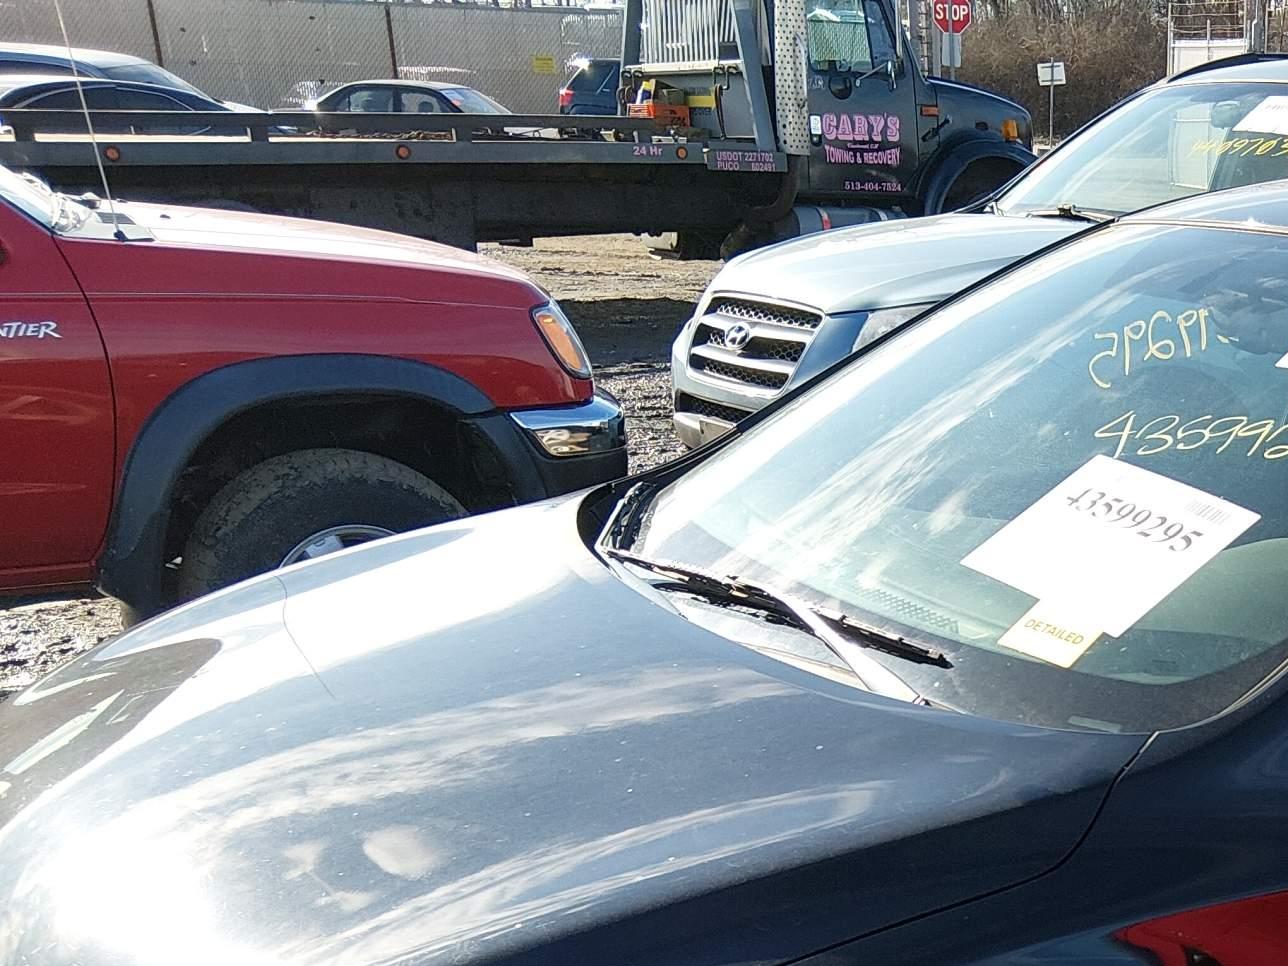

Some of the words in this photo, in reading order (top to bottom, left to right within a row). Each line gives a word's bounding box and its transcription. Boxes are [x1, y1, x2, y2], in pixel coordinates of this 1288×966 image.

[935, 3, 969, 21] STOP
[632, 145, 647, 156] 24
[649, 145, 663, 156] Hr
[824, 144, 855, 164] TOWING
[856, 152, 863, 164] &
[863, 146, 901, 165] RECOVERY
[1065, 487, 1204, 552] 43599295
[1023, 618, 1085, 646] DETAILED
